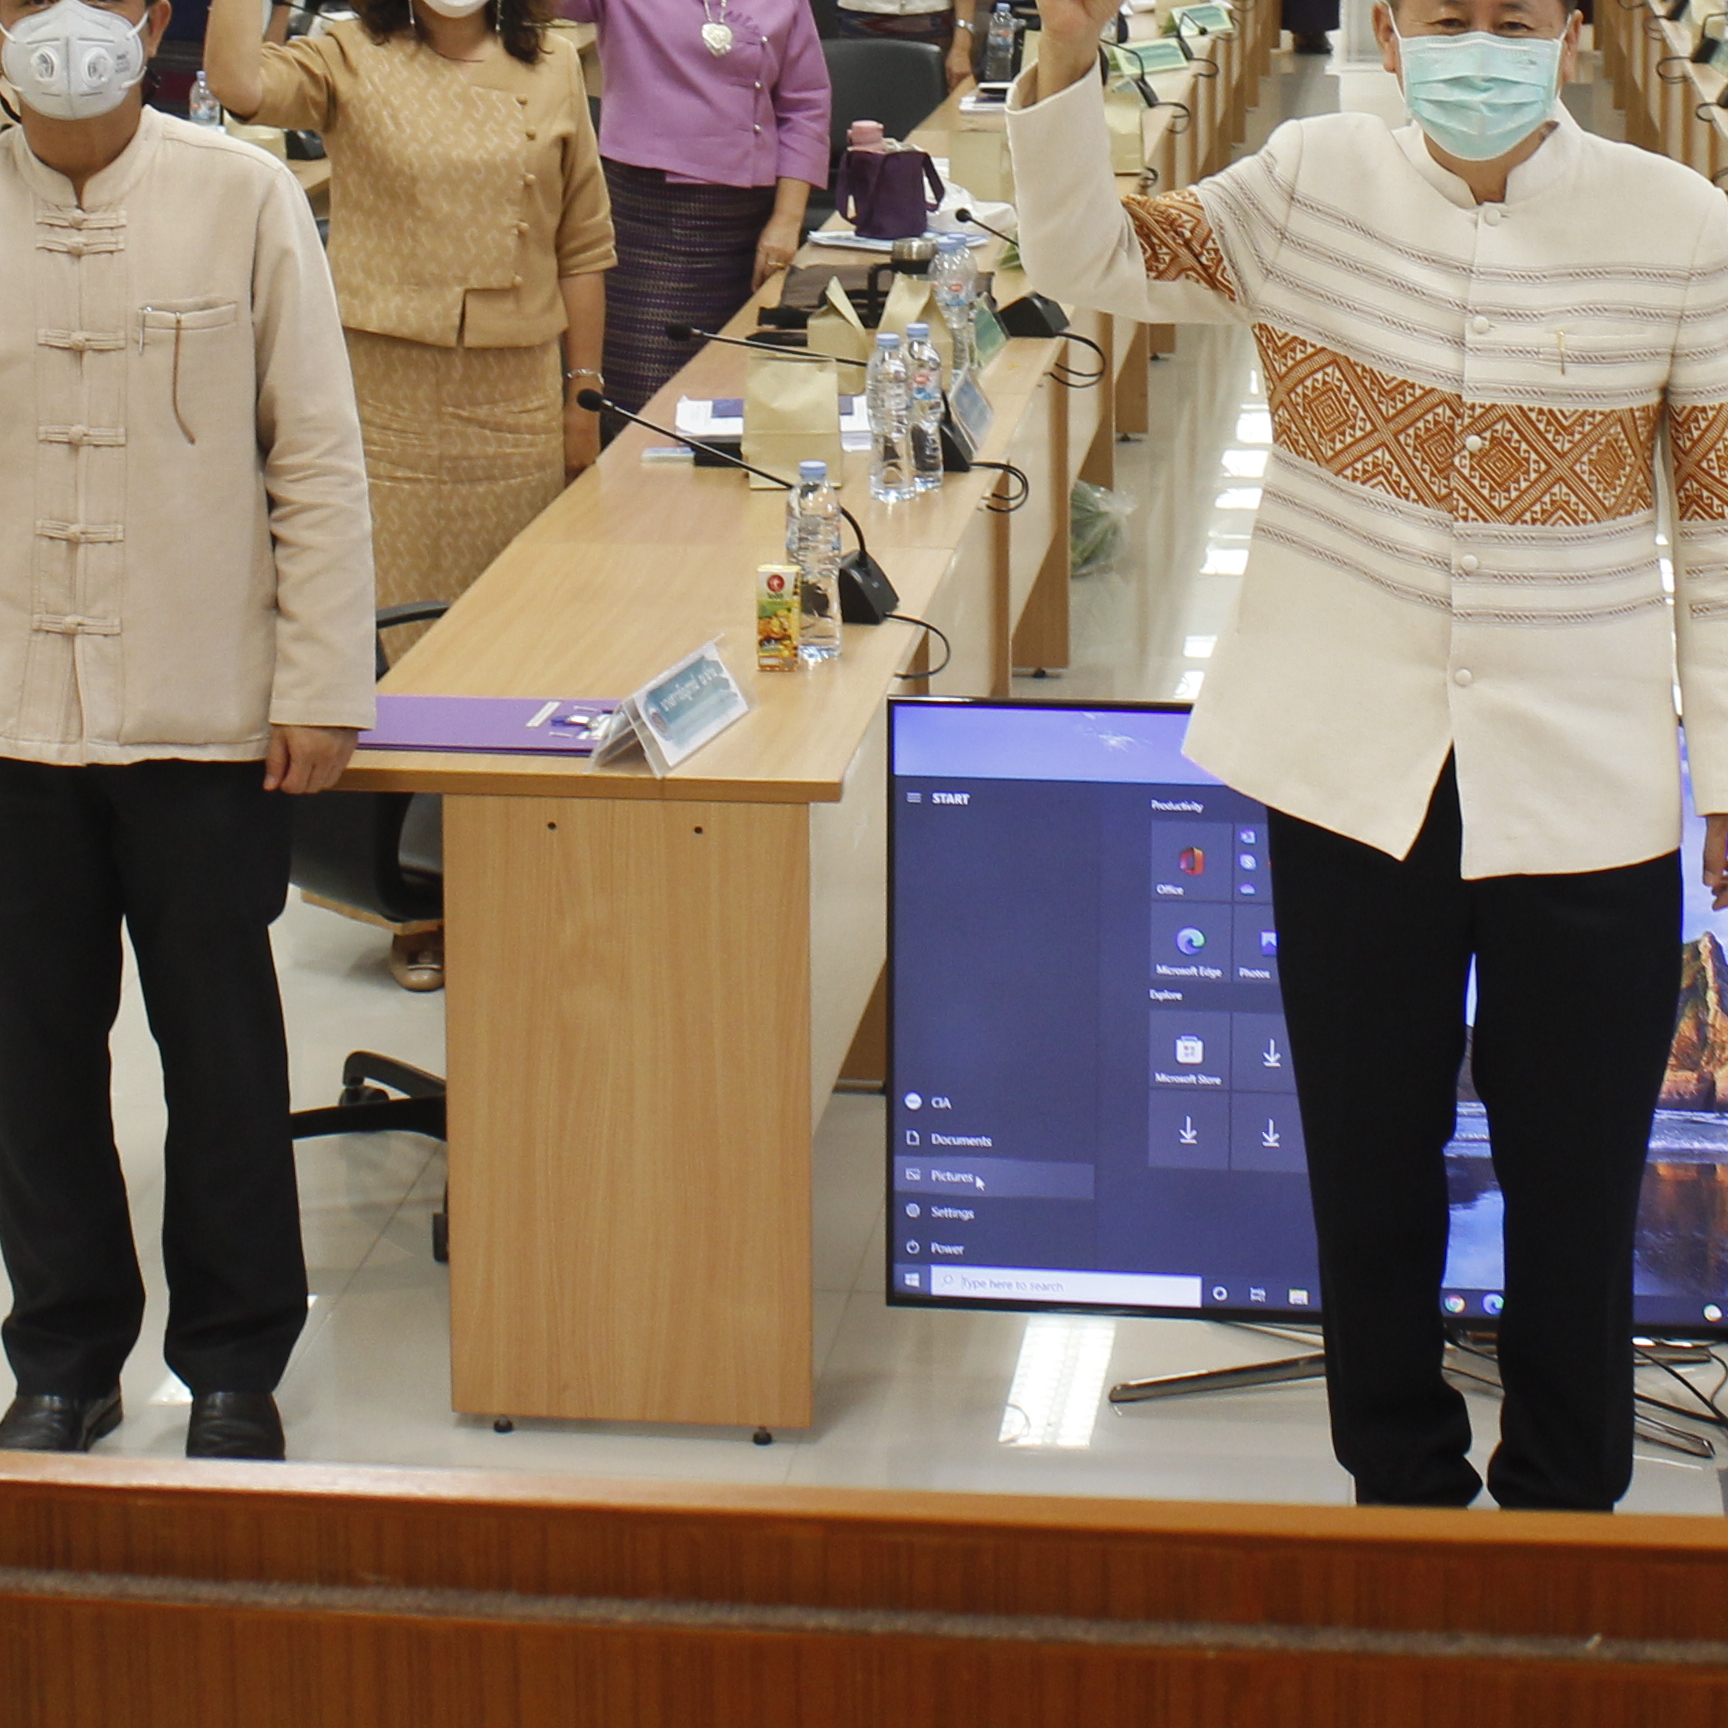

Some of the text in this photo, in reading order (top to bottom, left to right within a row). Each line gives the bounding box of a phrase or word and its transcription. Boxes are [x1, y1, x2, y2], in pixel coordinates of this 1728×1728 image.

[931, 792, 971, 806] START
[1151, 798, 1204, 814] Productivity
[1156, 883, 1185, 896] Office
[1156, 963, 1223, 980] Microsoft Edge
[1238, 967, 1271, 979] Photos
[1149, 988, 1183, 1003] Explore
[1154, 1072, 1222, 1086] Microsoft Store
[931, 1132, 993, 1148] Documents
[931, 1168, 974, 1183] Pictures
[930, 1205, 975, 1222] Settings
[930, 1241, 965, 1256] Power
[961, 1274, 1064, 1293] Type here to search
